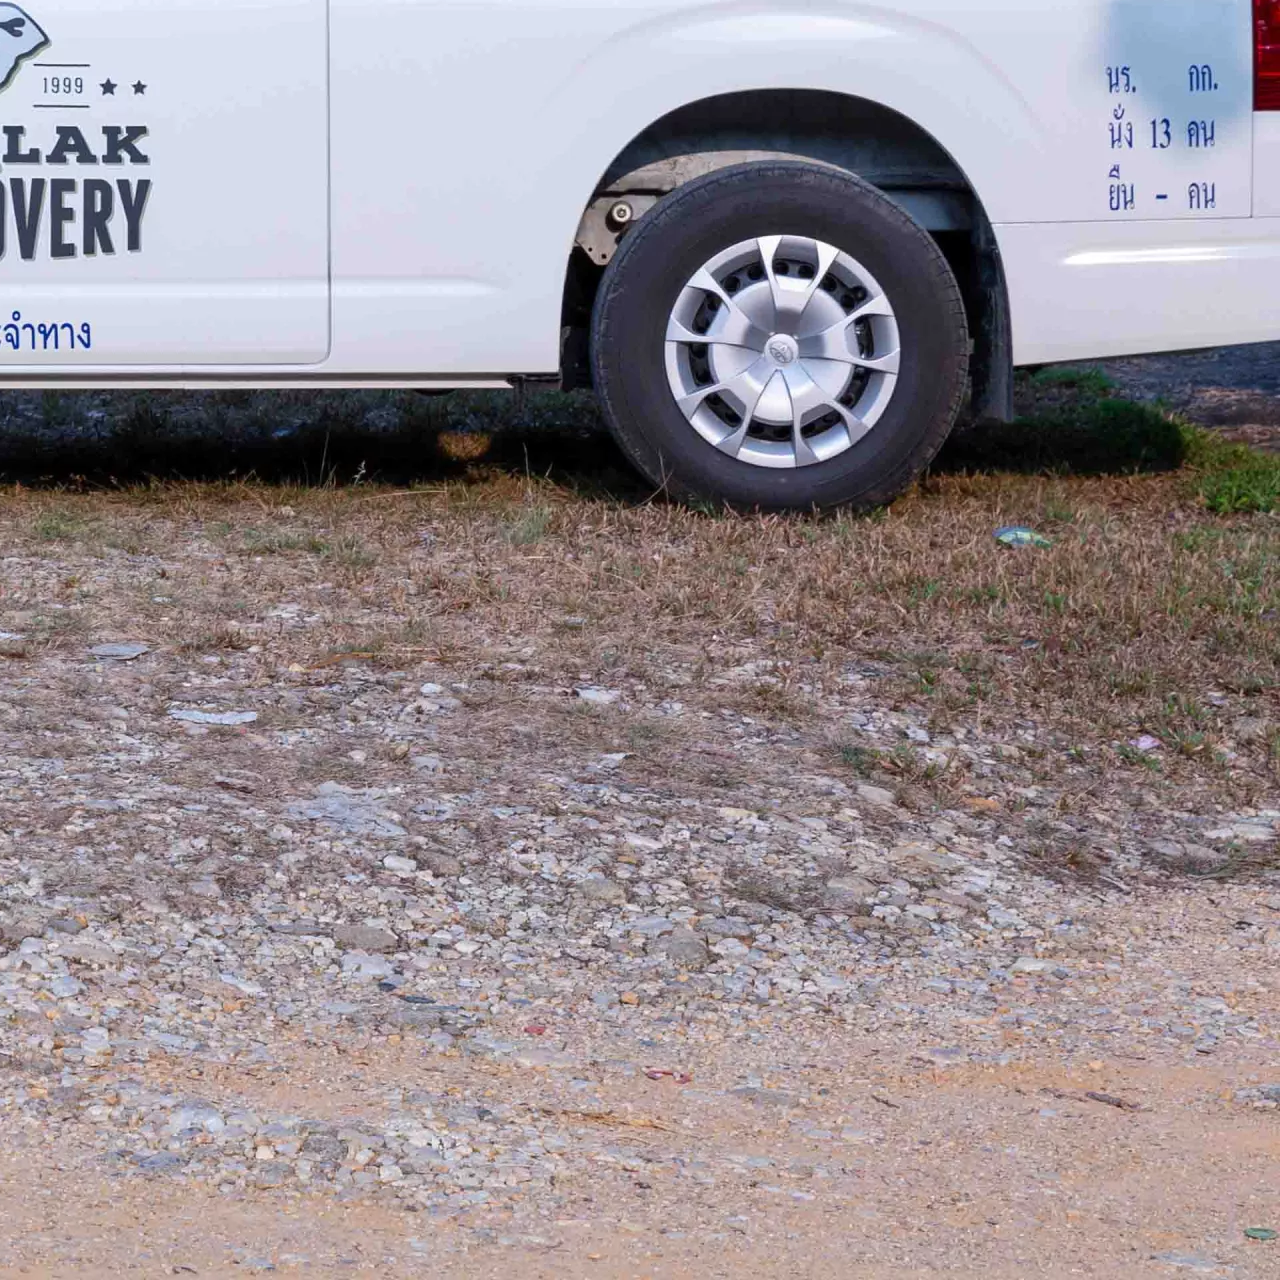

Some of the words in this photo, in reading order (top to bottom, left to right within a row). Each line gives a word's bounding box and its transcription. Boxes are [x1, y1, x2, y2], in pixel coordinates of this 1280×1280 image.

[42, 76, 84, 95] 1999
[1106, 65, 1137, 93] นร.
[1188, 64, 1219, 92] กก.
[2, 125, 151, 165] LAK
[1108, 103, 1134, 149] นั่ง
[1150, 117, 1172, 149] 13
[1187, 119, 1216, 148] คน
[1108, 164, 1136, 211] ยืน
[1187, 182, 1217, 209] คน
